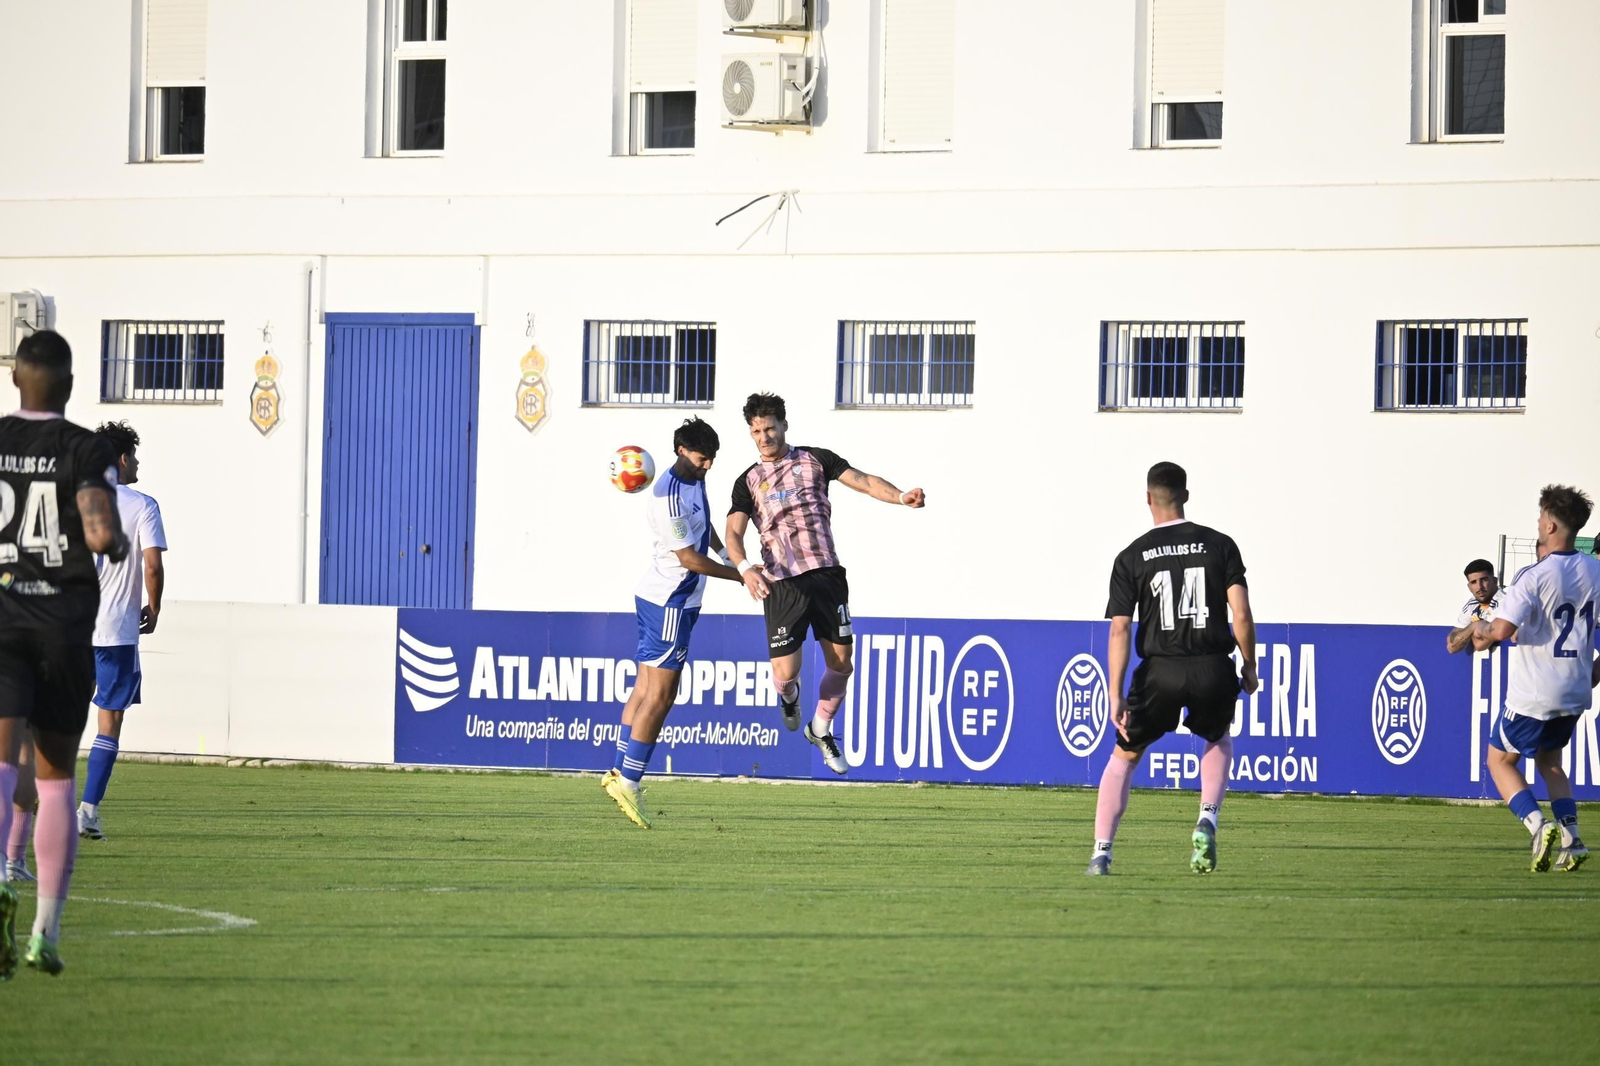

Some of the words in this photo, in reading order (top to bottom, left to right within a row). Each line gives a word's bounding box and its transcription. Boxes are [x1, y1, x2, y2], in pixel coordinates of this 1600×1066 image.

[1142, 544, 1189, 561] BOLLULLOS
[1190, 543, 1207, 554] C.F.
[1149, 567, 1209, 631] 14
[1554, 601, 1595, 658] 21
[469, 646, 637, 704] ATLANTIC
[673, 660, 779, 707] OPPER
[963, 669, 999, 698] RF
[829, 634, 945, 769] UTUR
[1074, 690, 1091, 703] RF
[1390, 696, 1408, 710] RF
[962, 708, 998, 736] EF
[1073, 707, 1091, 720] EF
[1390, 714, 1408, 728] EF
[465, 714, 495, 738] Una
[497, 717, 565, 744] compañía
[568, 717, 591, 741] del
[1150, 746, 1318, 782] FEDACIÓN
